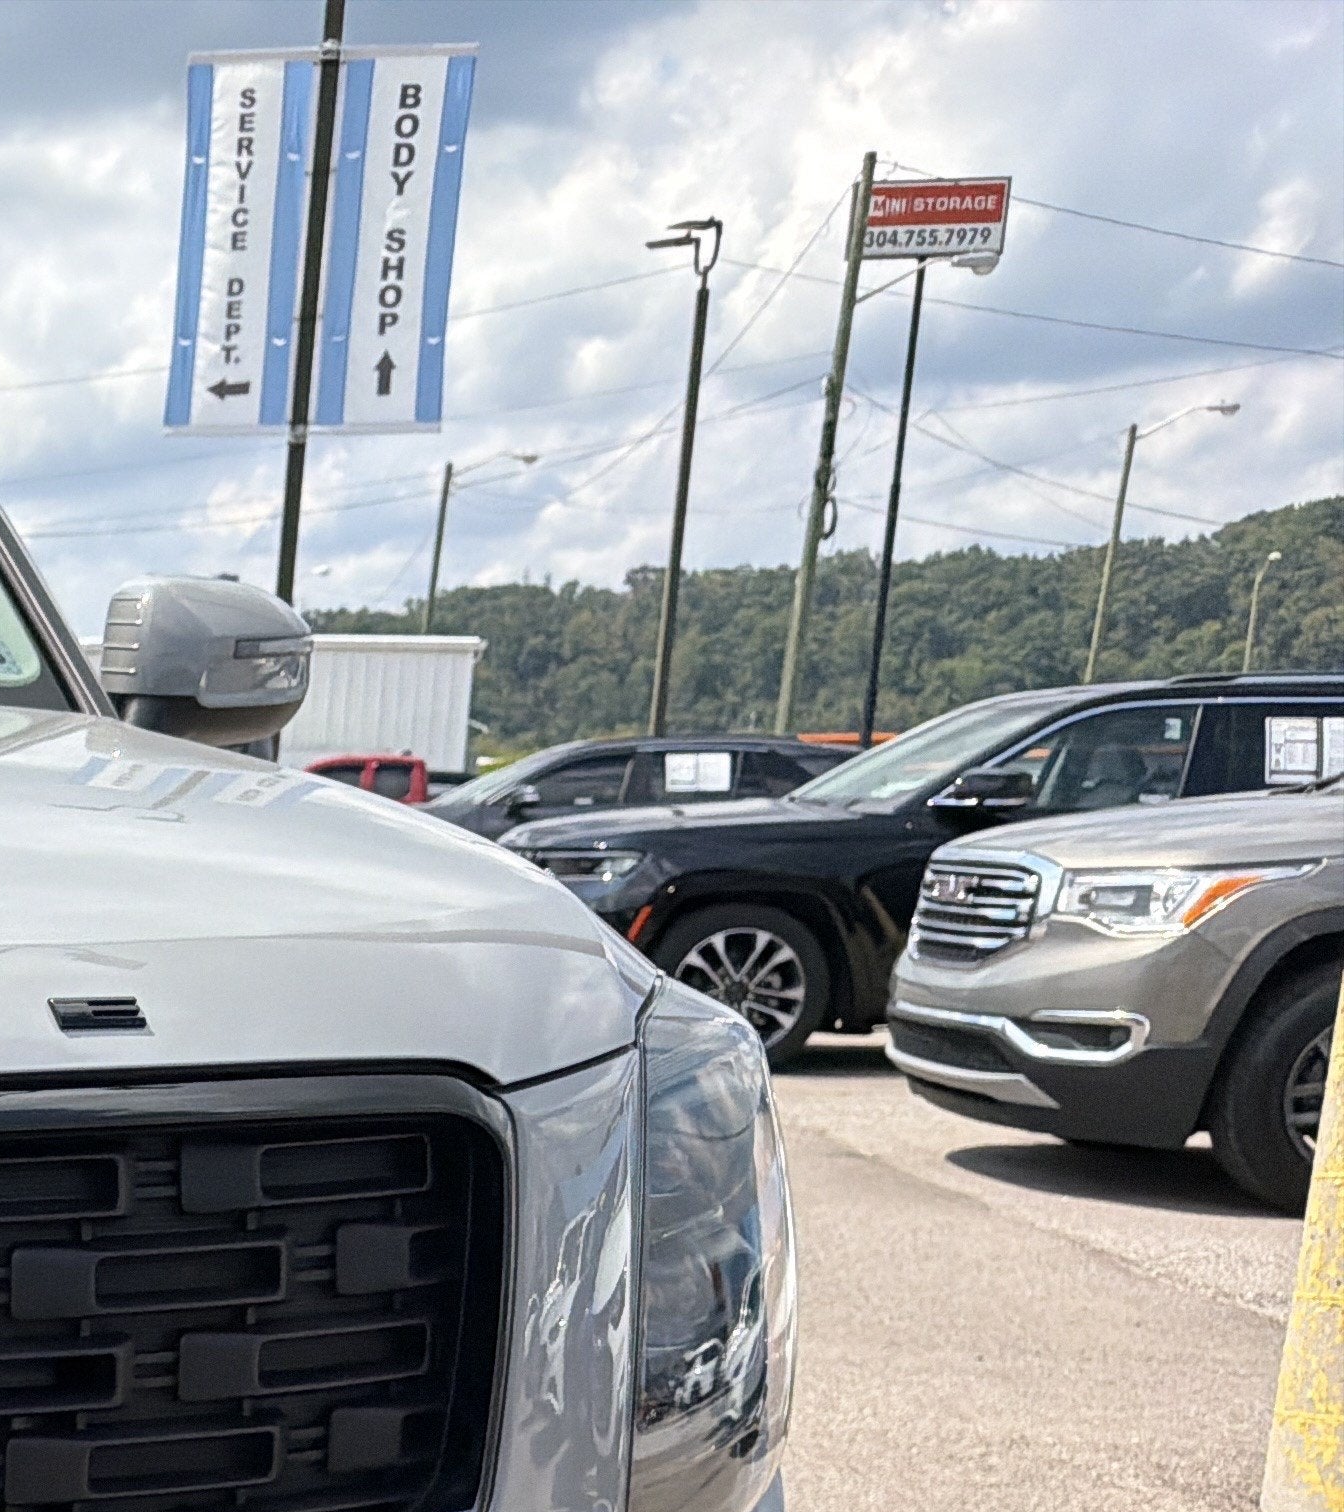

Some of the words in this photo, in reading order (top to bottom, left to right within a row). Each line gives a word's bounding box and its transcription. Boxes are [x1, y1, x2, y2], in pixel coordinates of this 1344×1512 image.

[230, 88, 256, 251] SERVICE
[390, 84, 422, 195] BODY
[864, 227, 991, 248] 304.755.7979
[913, 195, 998, 212] STORAGE
[223, 278, 244, 364] DEPT.
[377, 228, 406, 336] SHOP
